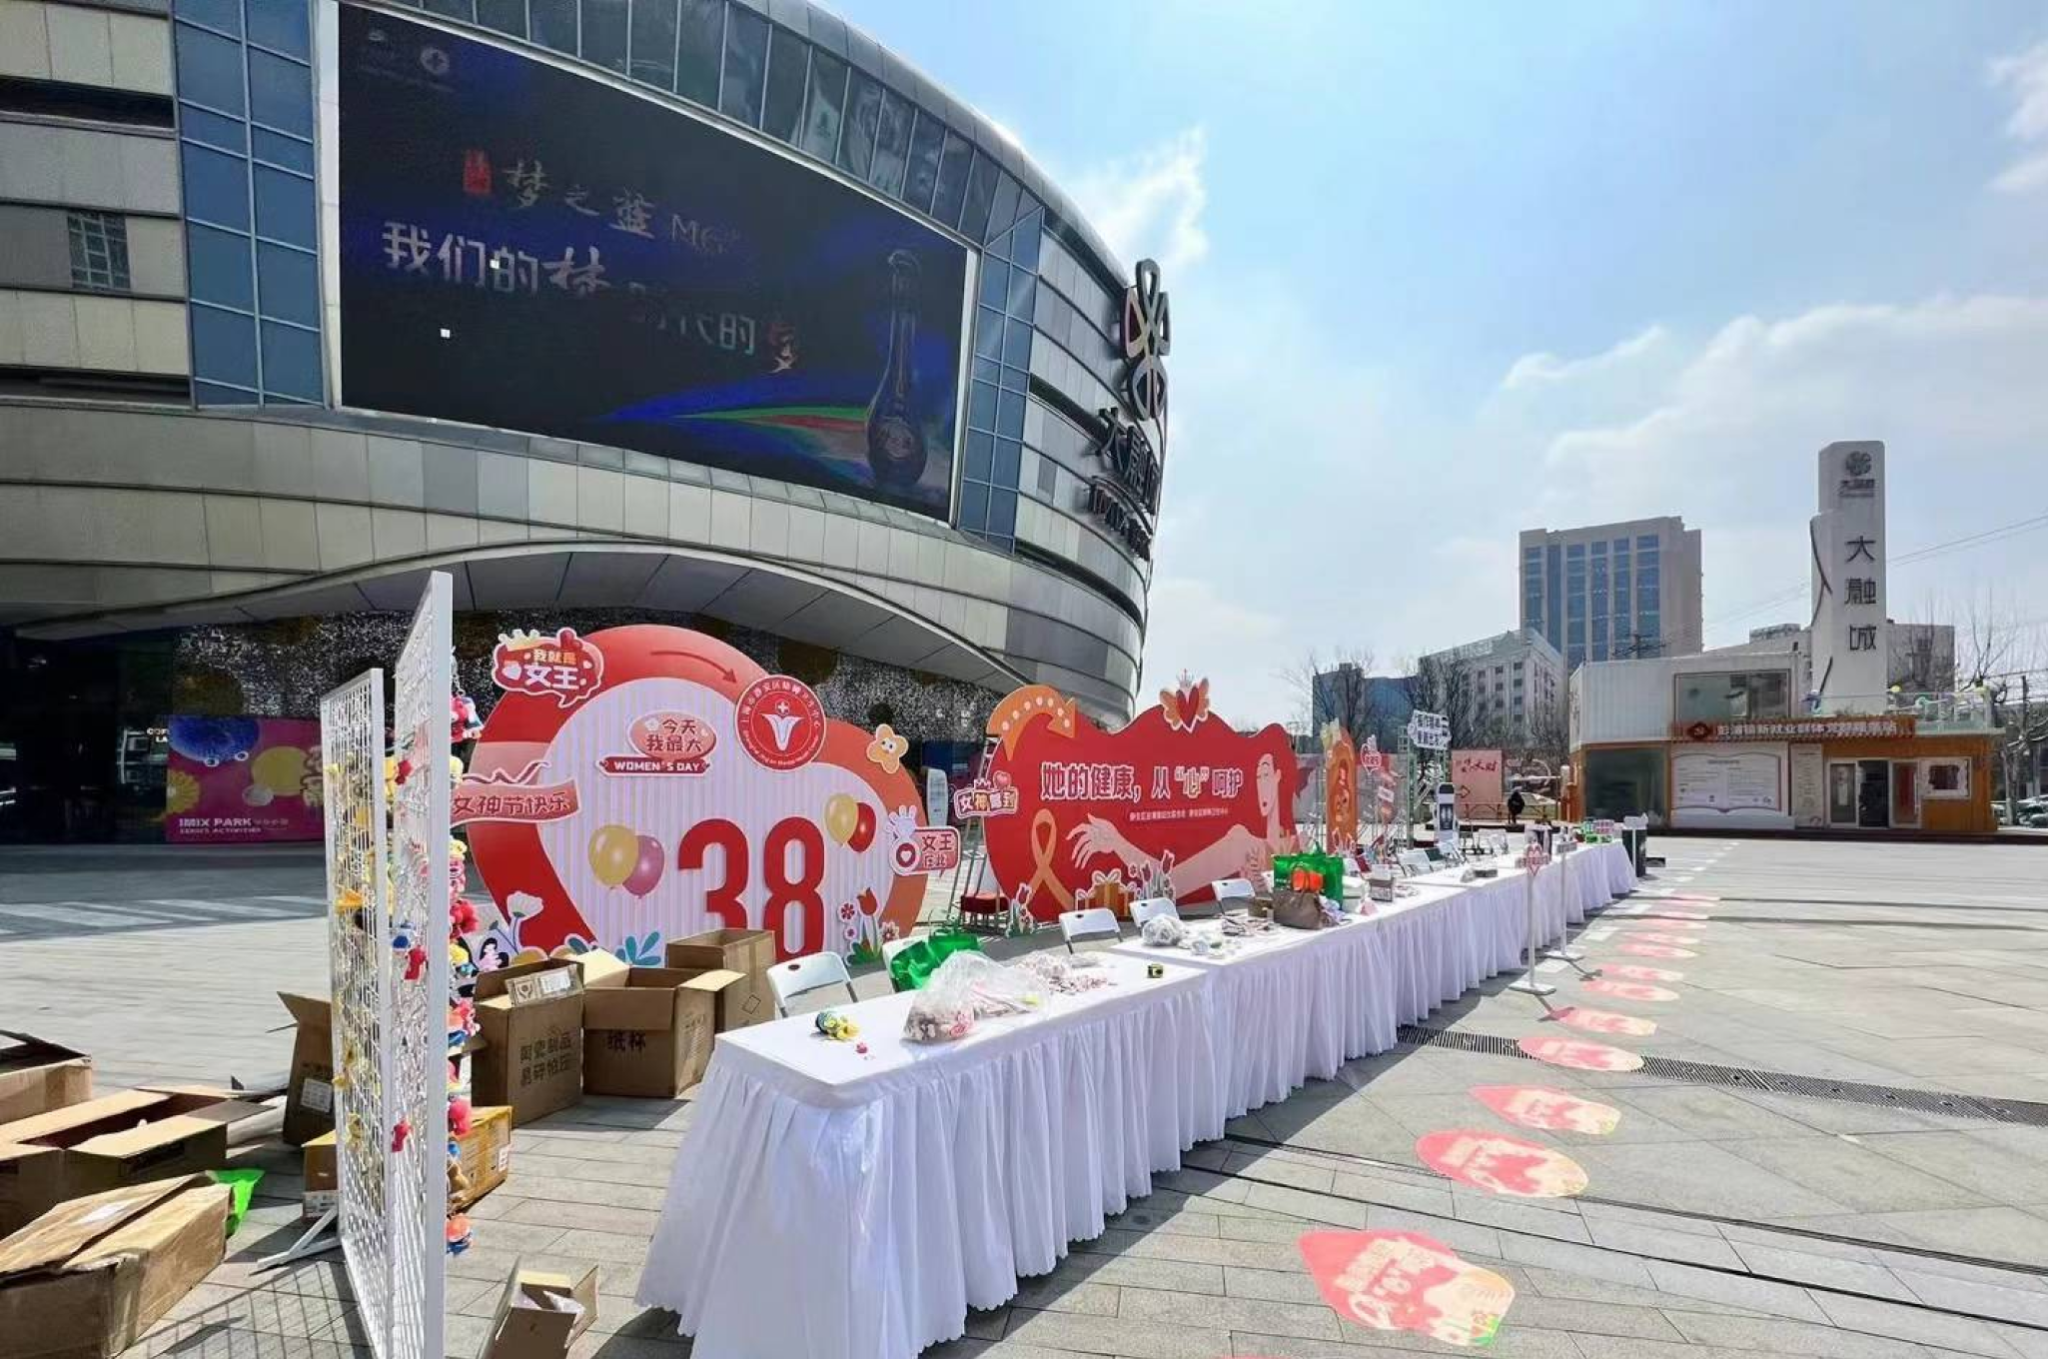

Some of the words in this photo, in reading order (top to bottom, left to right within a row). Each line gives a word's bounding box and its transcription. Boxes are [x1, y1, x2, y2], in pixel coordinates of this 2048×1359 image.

[1845, 535, 1877, 651] 大融城
[523, 664, 579, 689] 女王
[662, 718, 696, 735] 今天
[646, 734, 702, 752] 我最大
[614, 760, 675, 772] WOMEN'S
[676, 760, 701, 772] DAY
[453, 791, 569, 815] 女神节快乐
[213, 817, 252, 827] PARK
[921, 833, 953, 851] 女王
[678, 816, 825, 963] 38
[607, 1029, 647, 1053] 纸杯
